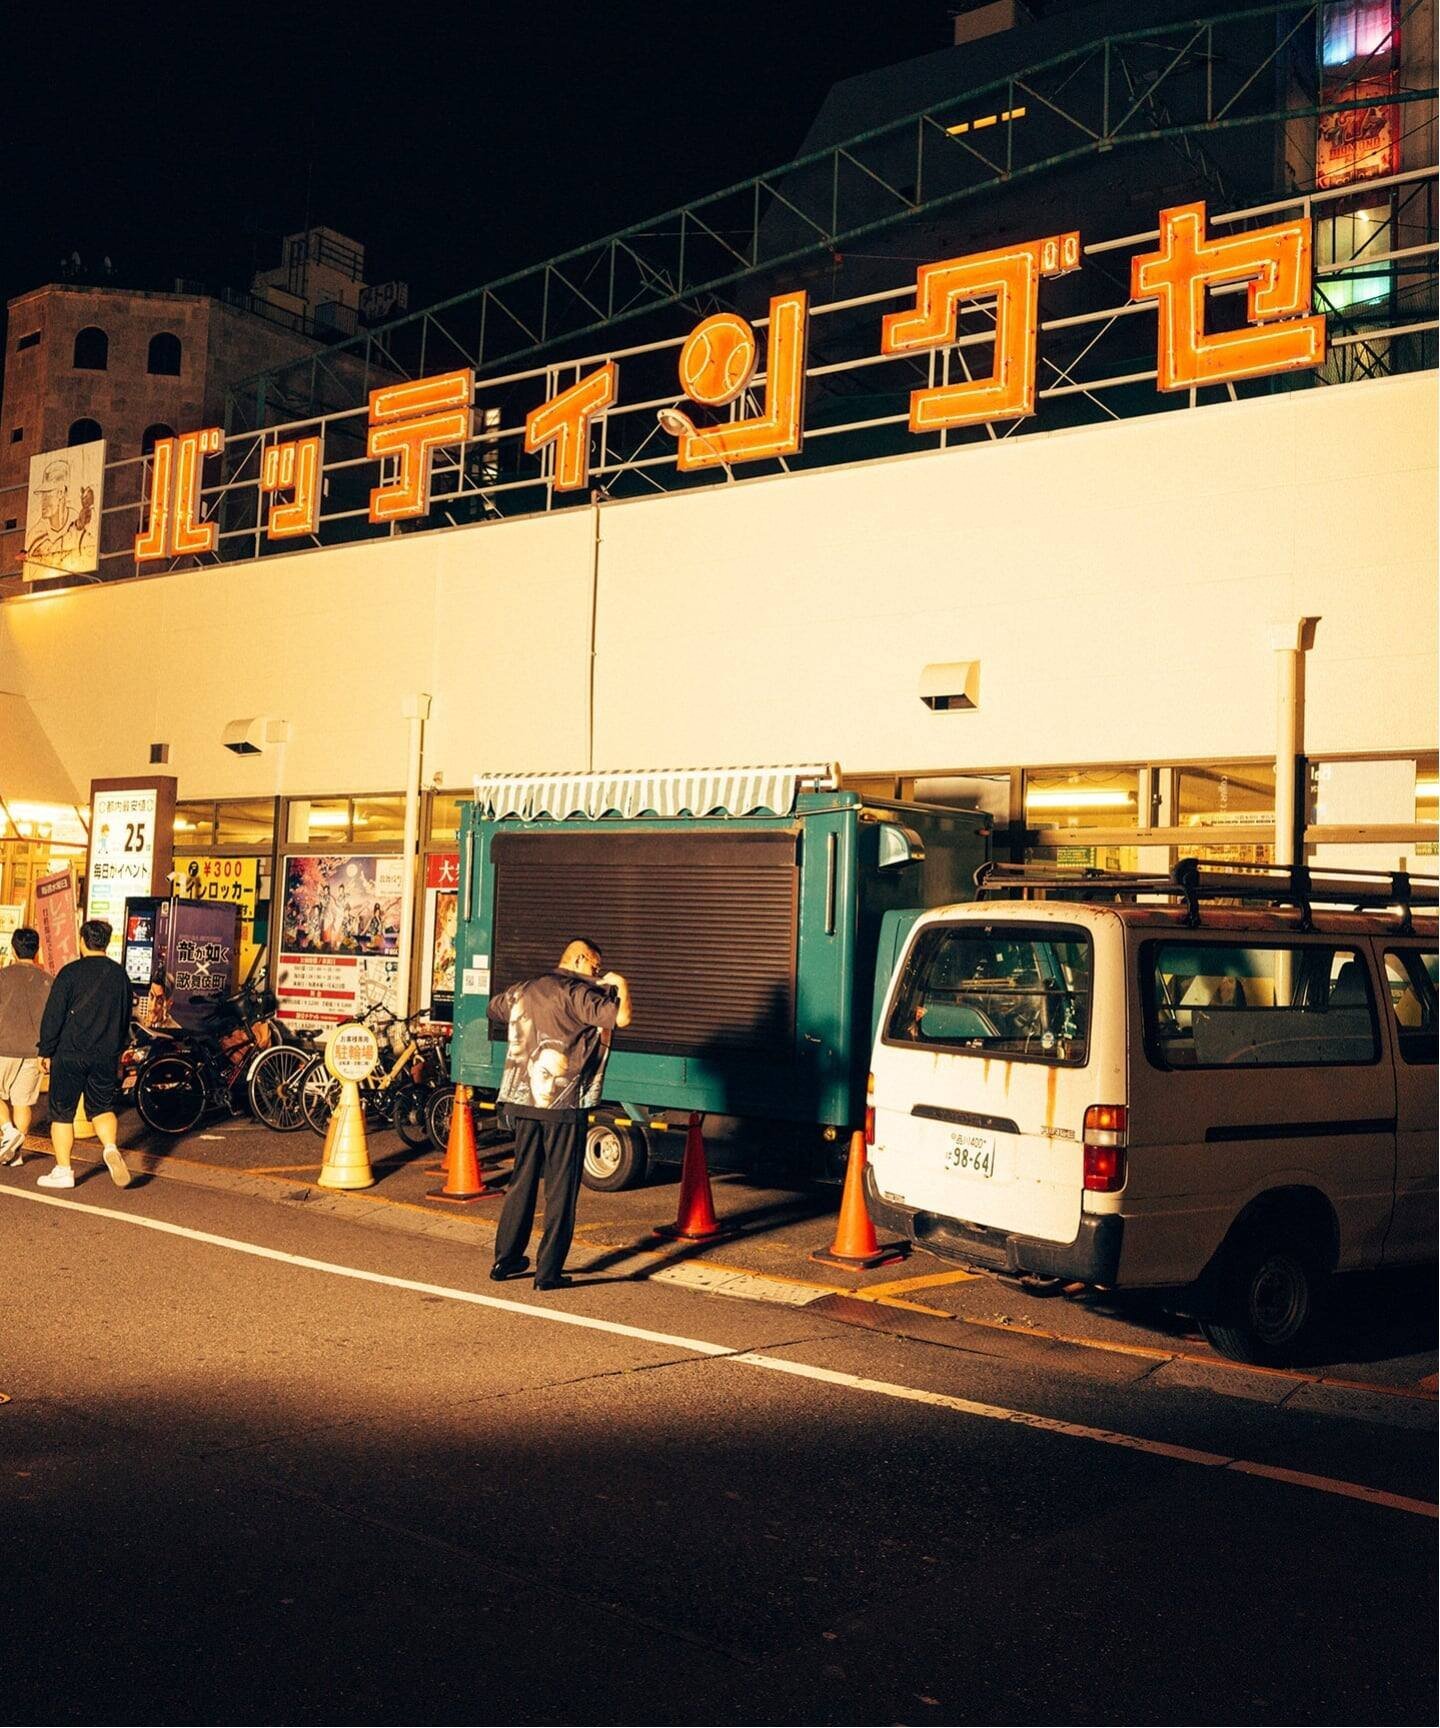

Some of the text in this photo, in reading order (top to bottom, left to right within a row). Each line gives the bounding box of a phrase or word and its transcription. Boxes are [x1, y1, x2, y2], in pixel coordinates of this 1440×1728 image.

[124, 823, 145, 852] 25
[203, 861, 242, 878] ¥300
[177, 940, 230, 963] 龍が如く
[176, 972, 226, 990] 歌舞伎町
[335, 1044, 374, 1060] 駐輪場
